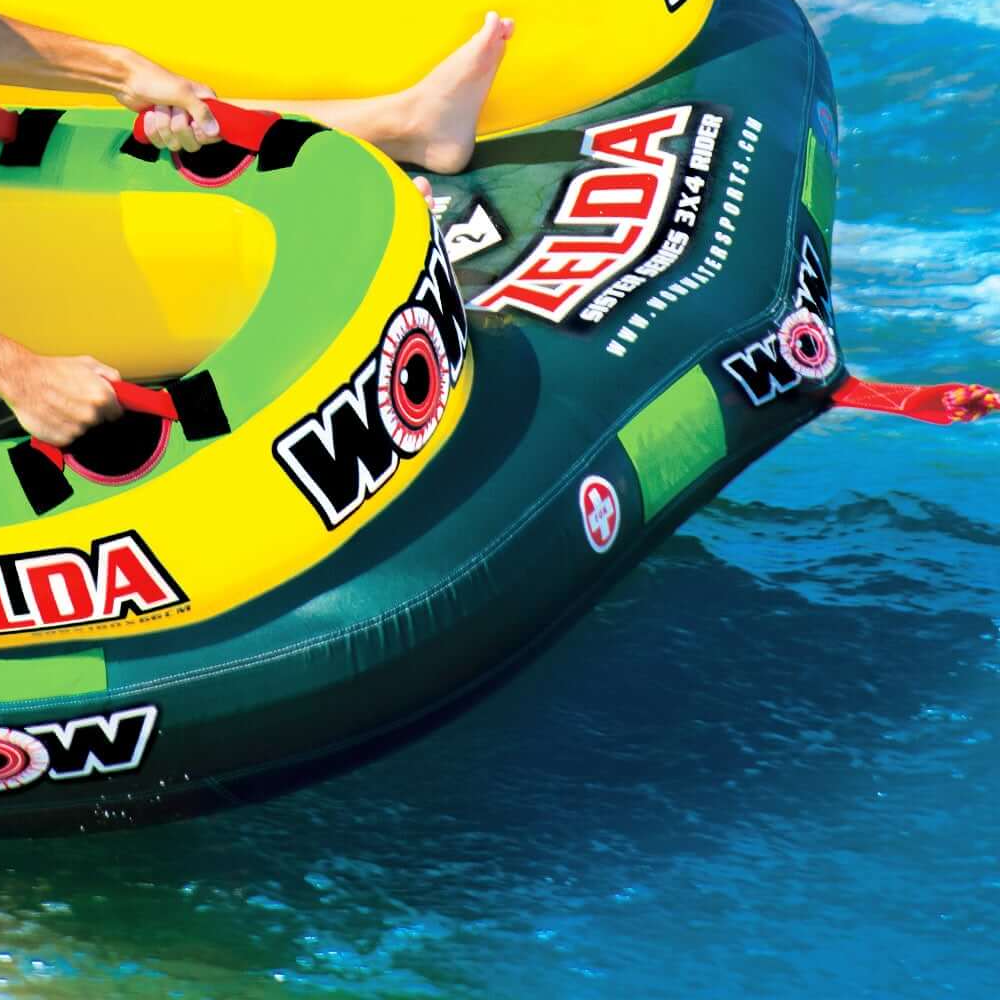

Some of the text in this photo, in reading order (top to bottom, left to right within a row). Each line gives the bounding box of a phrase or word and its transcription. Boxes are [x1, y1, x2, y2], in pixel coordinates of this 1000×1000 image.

[466, 105, 693, 322] ZELDA
[579, 113, 724, 323] SISTER SERIES 3X4 RIDER
[275, 217, 467, 526] WOW
[722, 235, 837, 407] WOW
